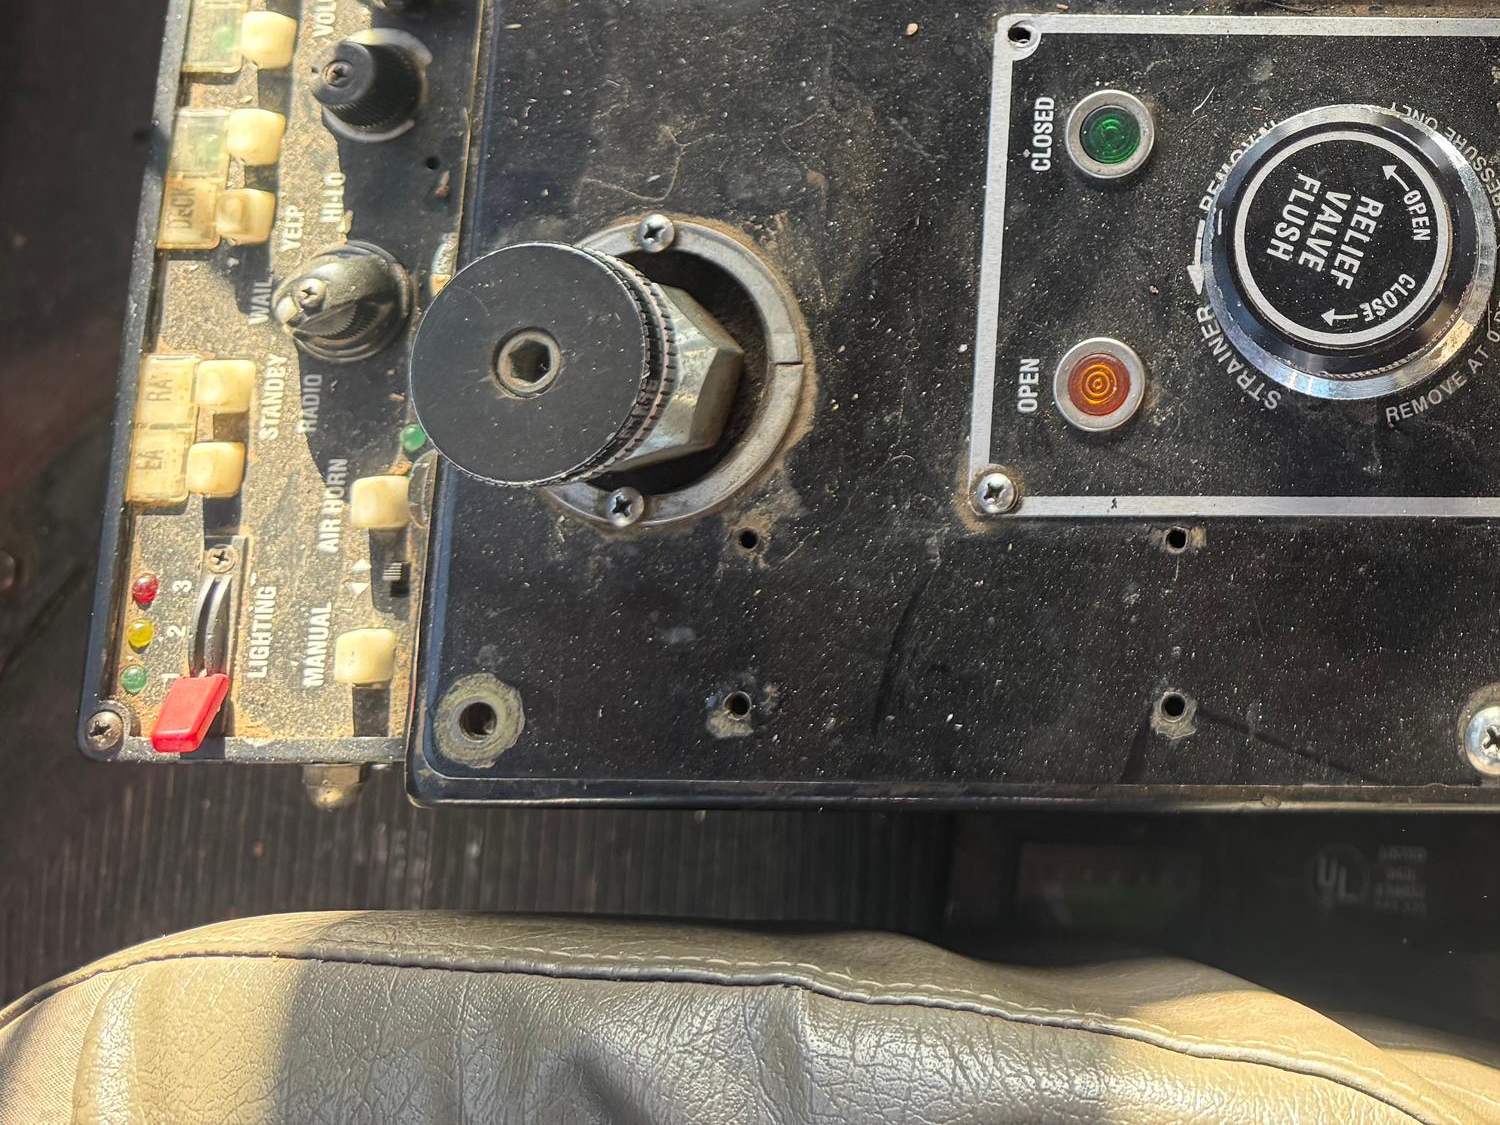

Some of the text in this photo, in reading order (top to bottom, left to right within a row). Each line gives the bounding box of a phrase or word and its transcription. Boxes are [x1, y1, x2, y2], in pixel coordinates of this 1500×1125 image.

[1030, 96, 1054, 171] CLOSED
[1388, 102, 1439, 129] ONLY
[321, 172, 346, 226] HI-LO
[1266, 172, 1321, 262] FLUSH
[1403, 189, 1431, 241] OPEN
[1298, 189, 1351, 273] VALVE
[1330, 195, 1384, 290] RELIEF
[248, 276, 273, 325] WAIL
[1359, 273, 1416, 323] CLOSE
[1197, 306, 1281, 410] STRAINER
[1467, 345, 1490, 376] AT
[1486, 330, 1500, 343] 0
[258, 353, 288, 441] STANDBY
[295, 374, 323, 434] RADIO
[1016, 357, 1040, 413] OPEN
[1385, 375, 1467, 424] REMOVE
[316, 458, 350, 553] AIR HORN
[172, 580, 192, 593] 3
[166, 625, 186, 637] 2
[247, 585, 278, 679] LIGHTING
[302, 602, 333, 687] MANUAL
[1317, 855, 1359, 903] UL
